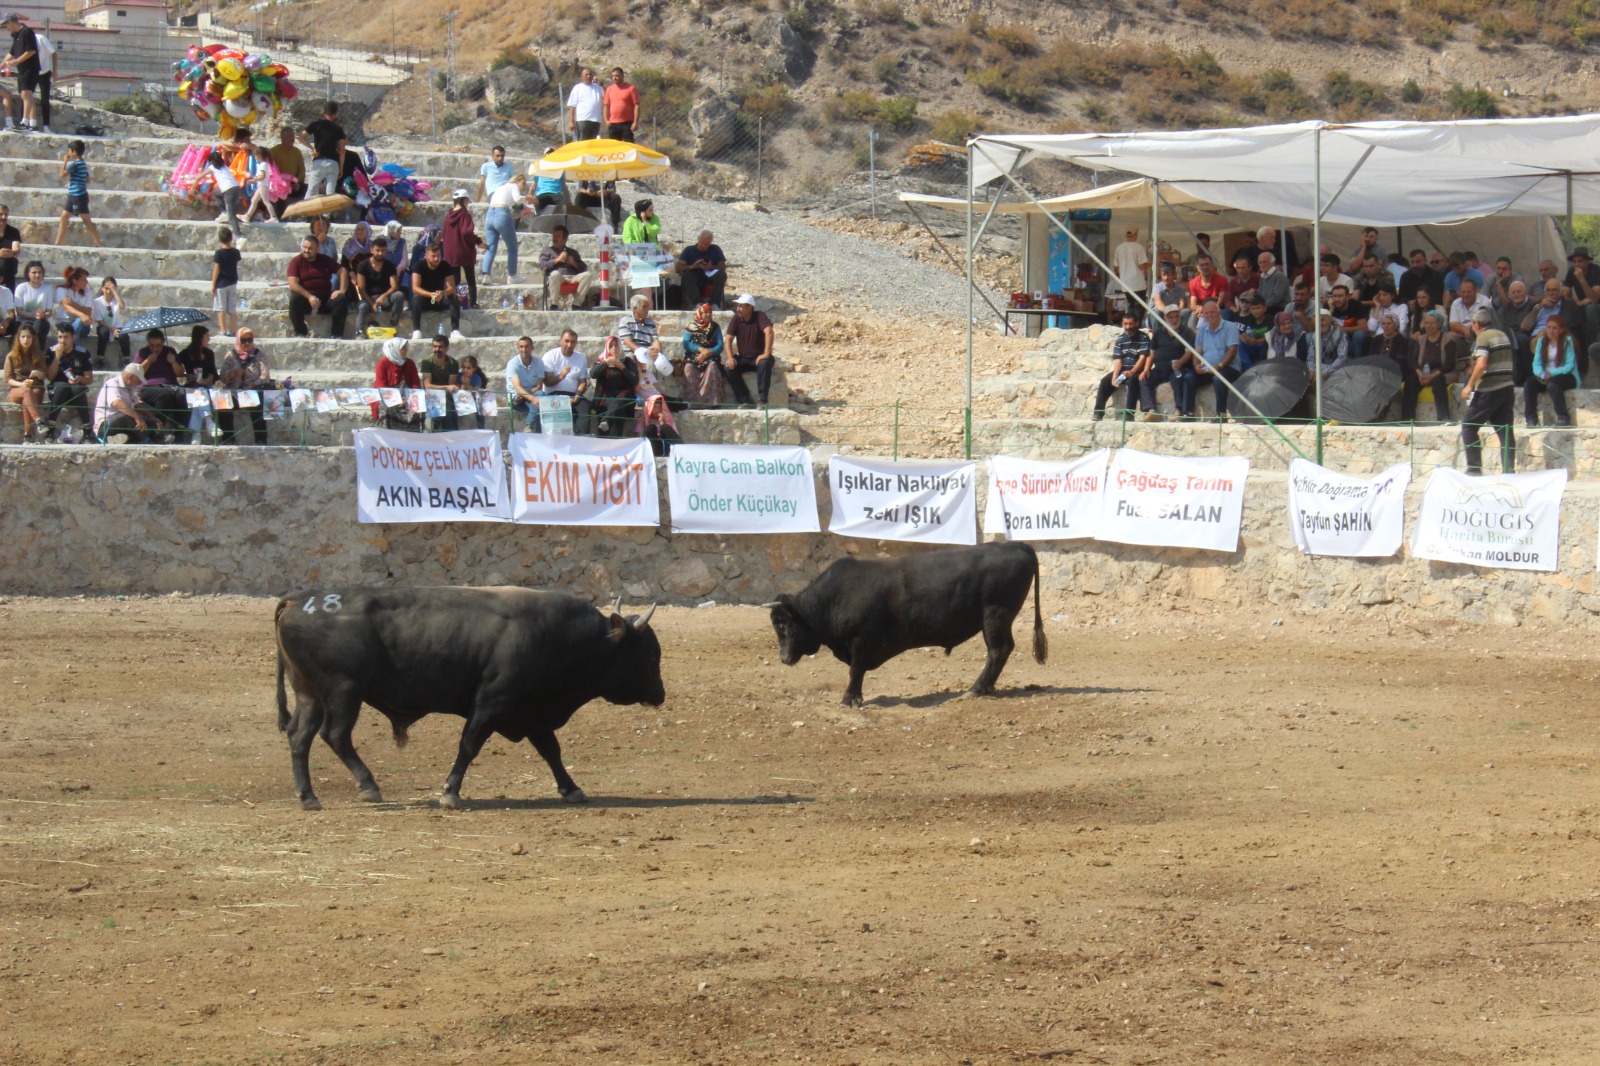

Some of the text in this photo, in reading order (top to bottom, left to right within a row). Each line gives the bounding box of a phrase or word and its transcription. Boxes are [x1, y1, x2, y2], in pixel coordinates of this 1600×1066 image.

[371, 445, 493, 476] POYRAZ ÇELİK YAPI
[674, 456, 805, 478] Kayra Cam Balkon
[523, 454, 644, 505] EKİM YİĞİT
[838, 470, 966, 495] Işıklar Nakliyat
[1021, 473, 1062, 495] Sürücü
[376, 485, 496, 513] AKIN BAŞAL
[688, 489, 797, 517] Önder Küçükay
[1116, 500, 1150, 518] Fua
[904, 504, 942, 528] IŞIK
[1300, 507, 1372, 536] Tayfun ŞAHİN
[1439, 526, 1484, 543] Harita
[1485, 551, 1540, 564] MOLDUR
[302, 593, 343, 615] 48
